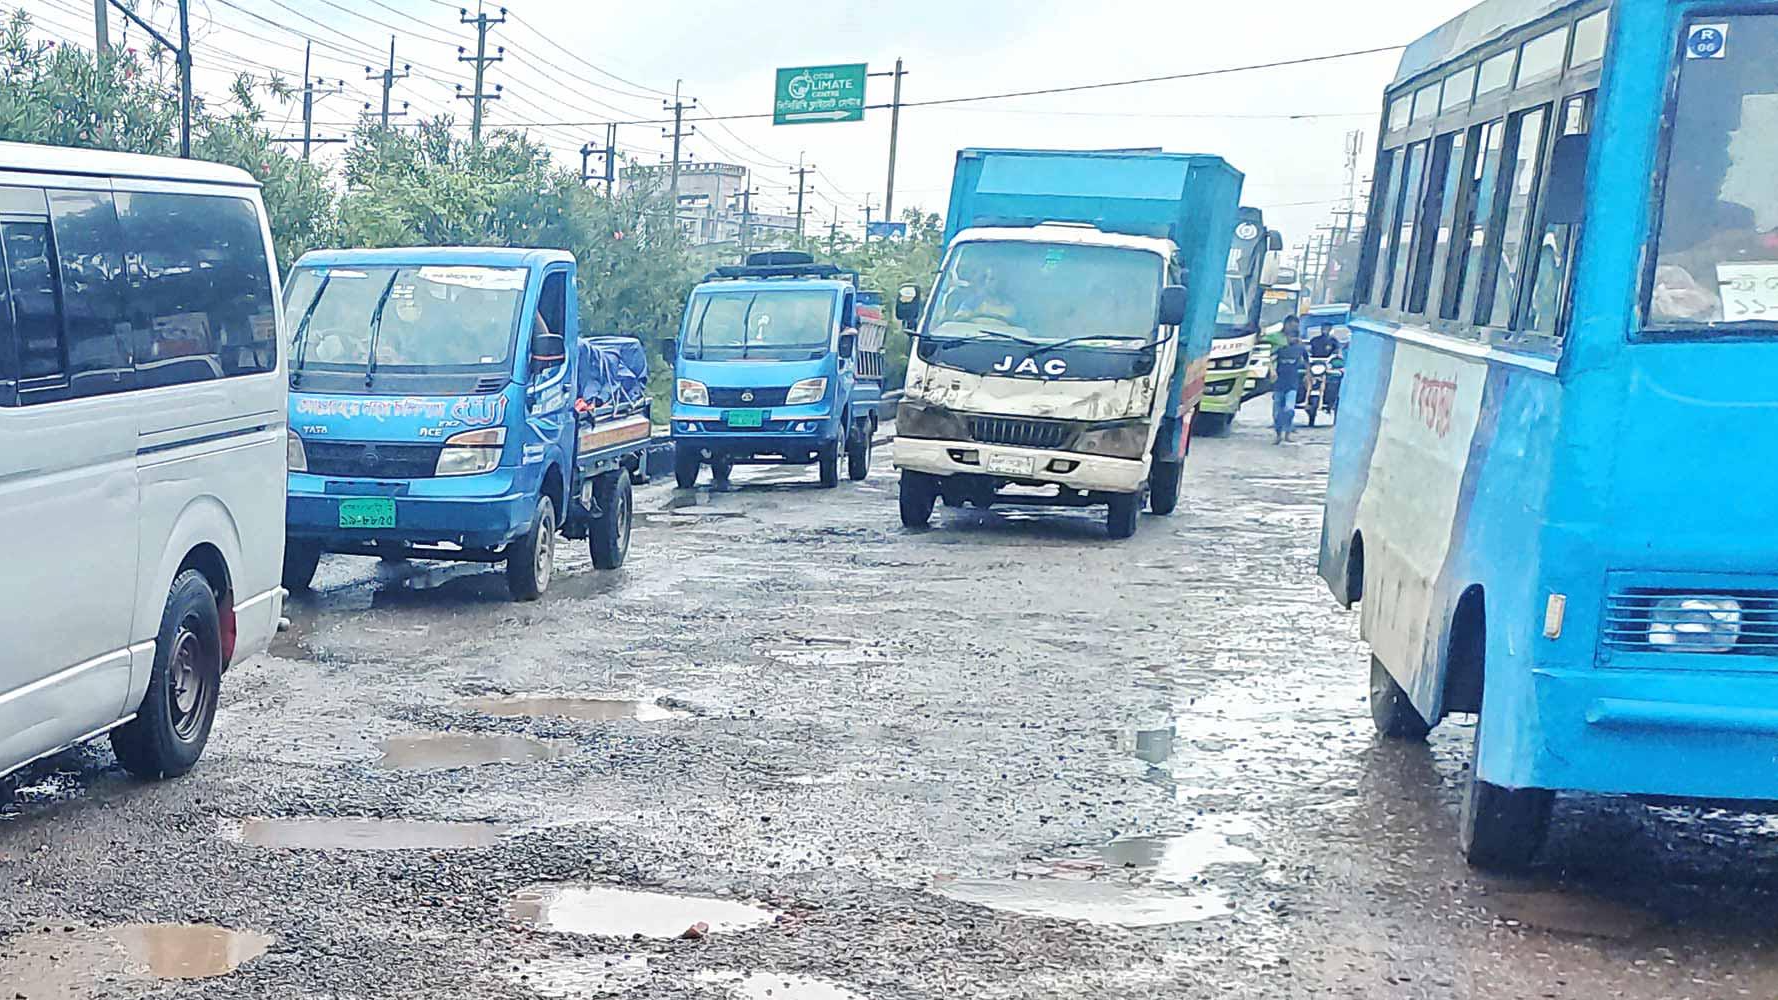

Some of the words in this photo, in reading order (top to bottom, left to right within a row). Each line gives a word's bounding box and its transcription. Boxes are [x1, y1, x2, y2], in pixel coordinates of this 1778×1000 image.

[1701, 30, 1714, 40] R
[993, 355, 1067, 375] JAC
[303, 425, 328, 433] TATA
[419, 427, 442, 436] ACE
